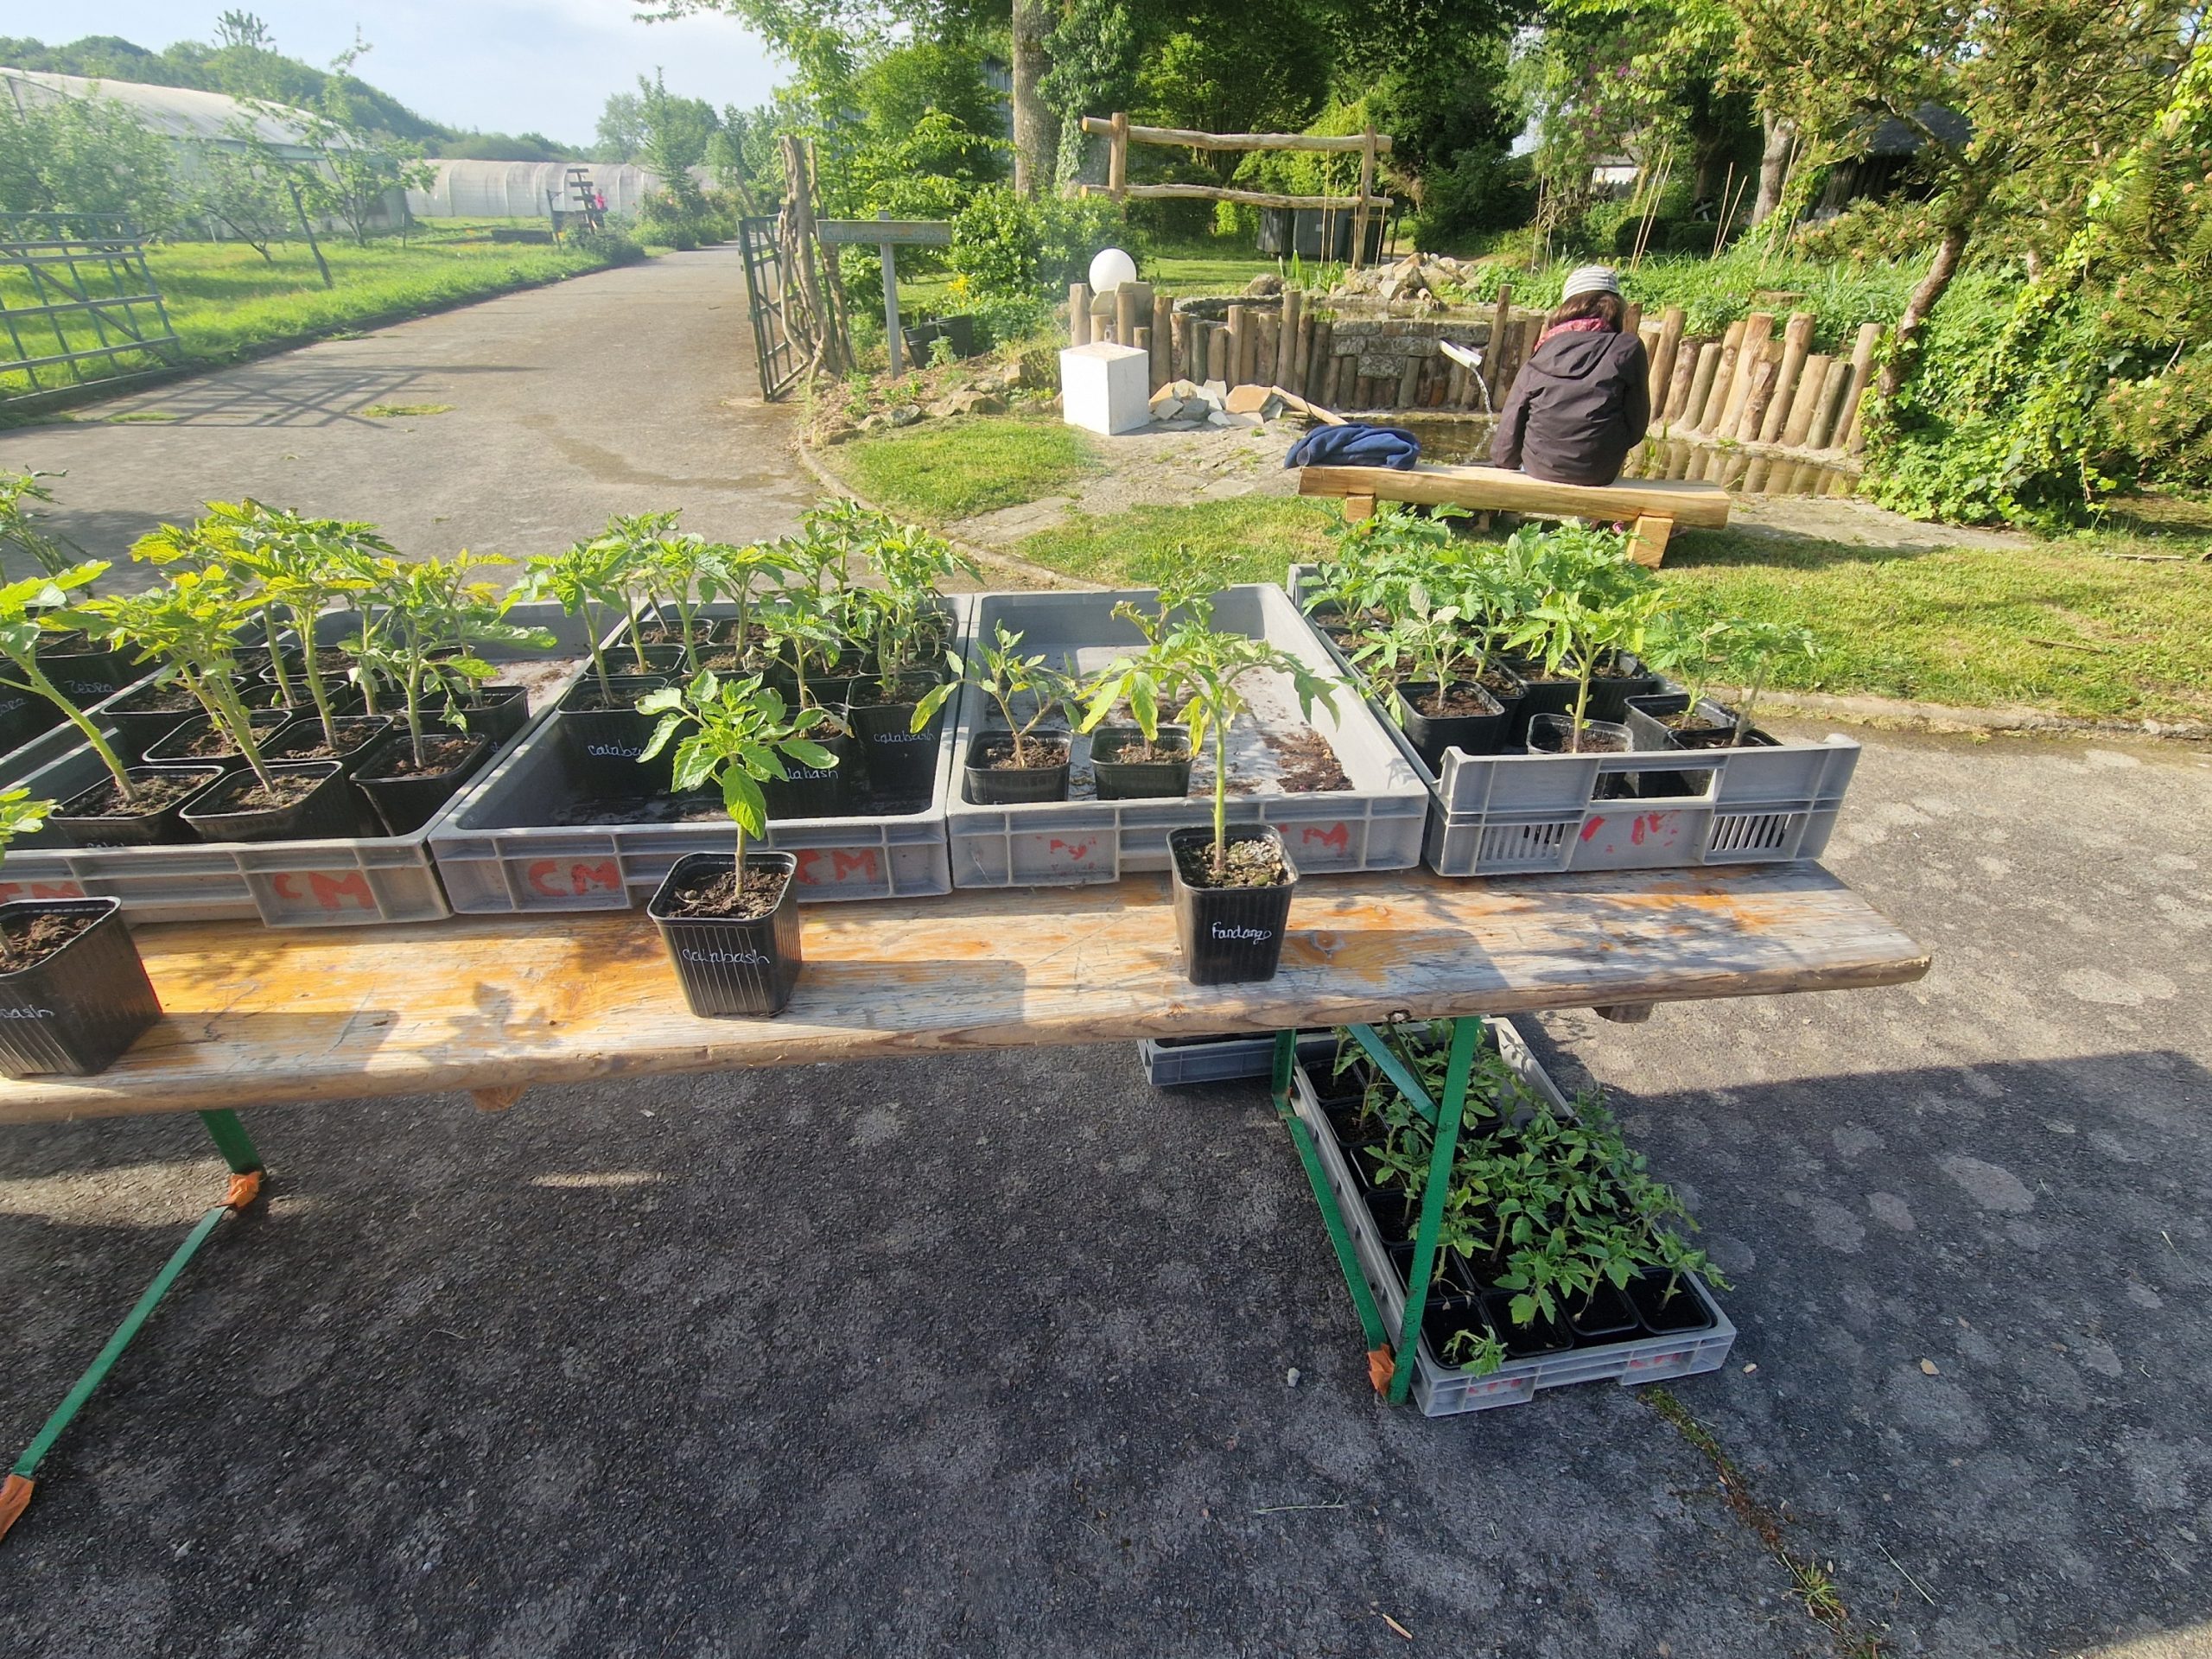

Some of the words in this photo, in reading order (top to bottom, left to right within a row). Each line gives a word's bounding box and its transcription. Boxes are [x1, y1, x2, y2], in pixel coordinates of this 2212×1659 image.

[528, 861, 620, 897] CM
[795, 849, 876, 885] CM
[274, 871, 375, 910] CM
